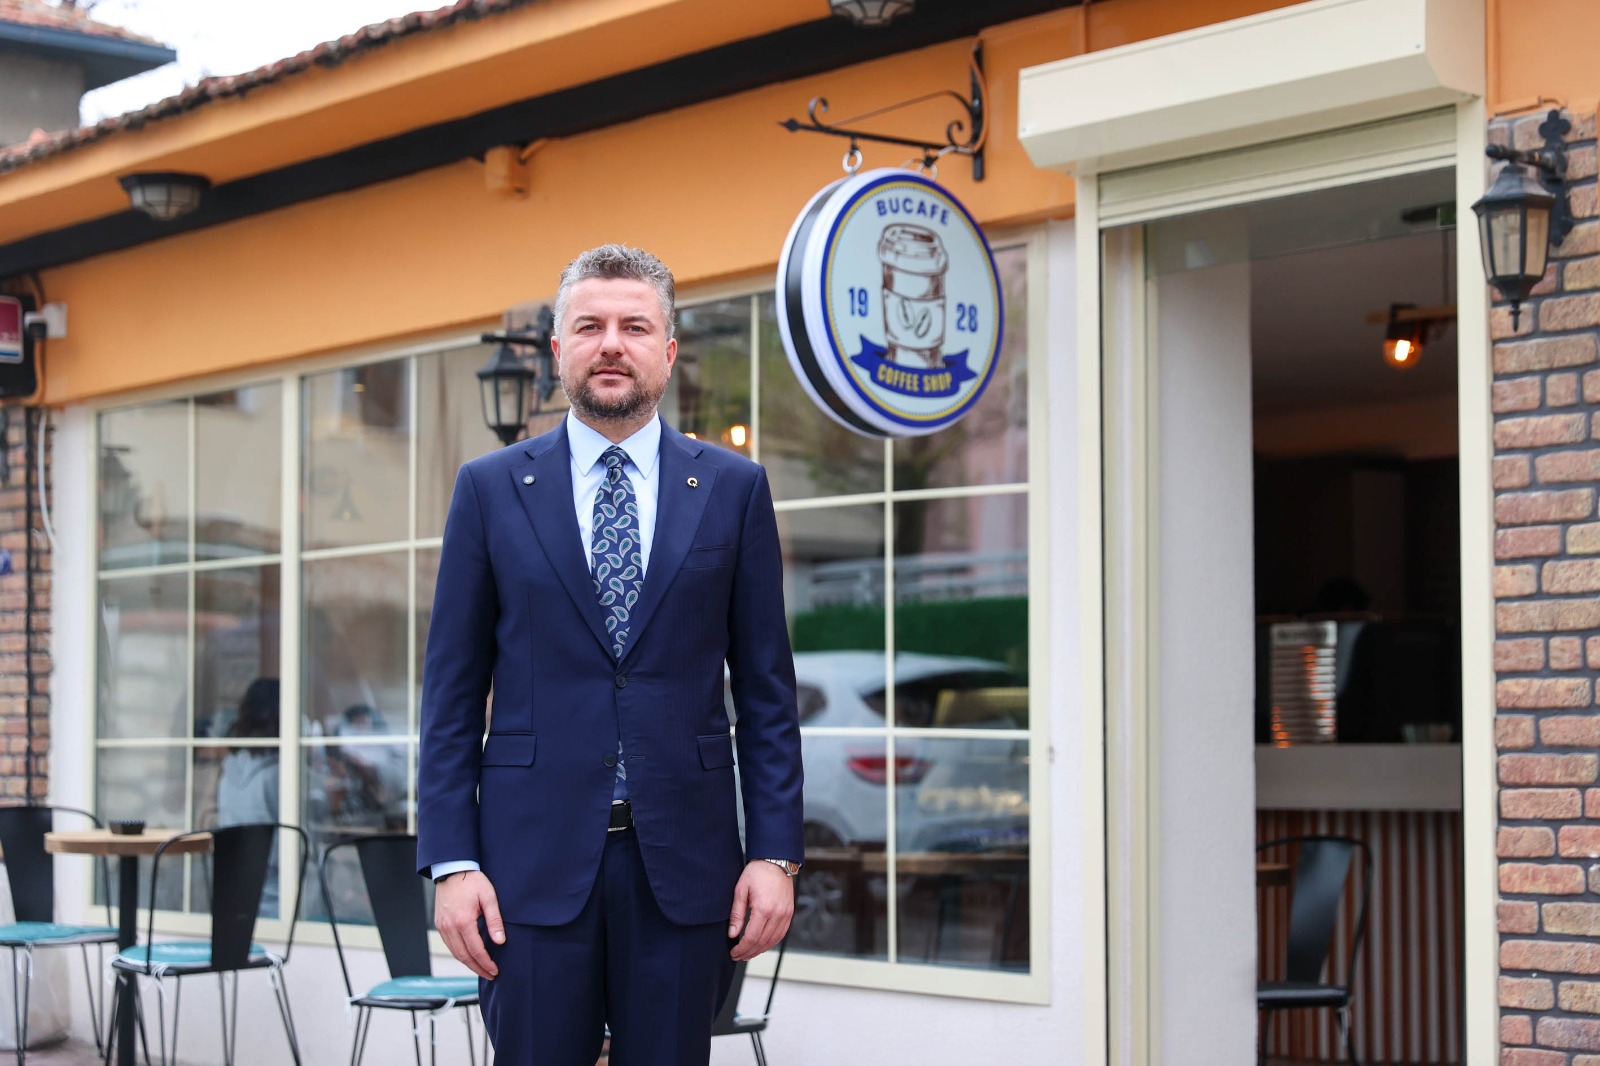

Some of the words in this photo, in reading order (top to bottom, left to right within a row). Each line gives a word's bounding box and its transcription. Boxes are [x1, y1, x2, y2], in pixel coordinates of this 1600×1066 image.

[876, 197, 949, 225] BUCAFE
[848, 287, 869, 317] 19
[956, 303, 978, 332] 28
[877, 364, 919, 392] COFFEE
[923, 372, 952, 392] SHOP
